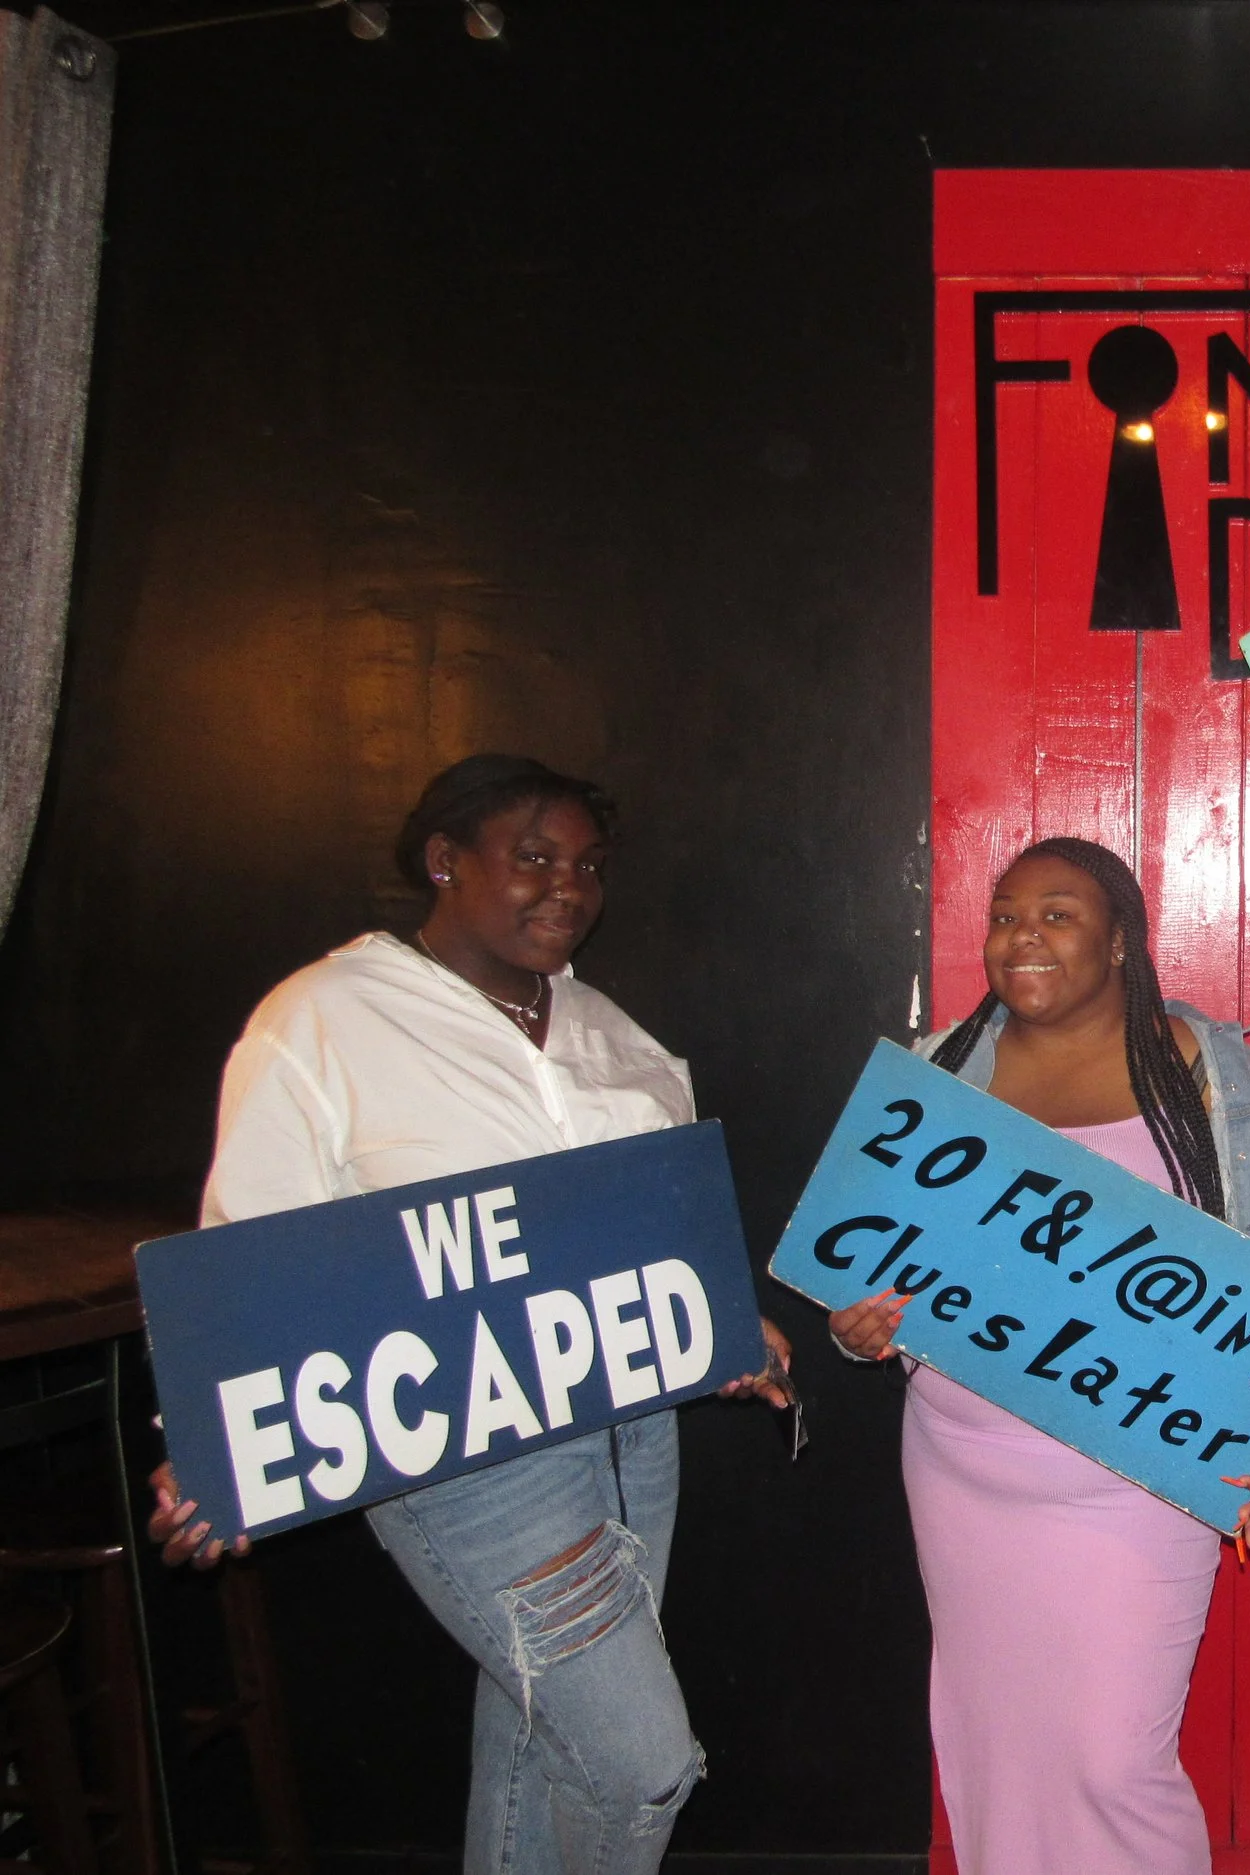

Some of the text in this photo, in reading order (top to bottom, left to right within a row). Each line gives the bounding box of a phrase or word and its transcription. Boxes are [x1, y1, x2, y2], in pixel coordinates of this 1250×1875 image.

[859, 1098, 988, 1189] 20
[400, 1185, 531, 1300] WE
[217, 1258, 715, 1529] ESCAPED
[813, 1214, 1250, 1463] Clues Later
